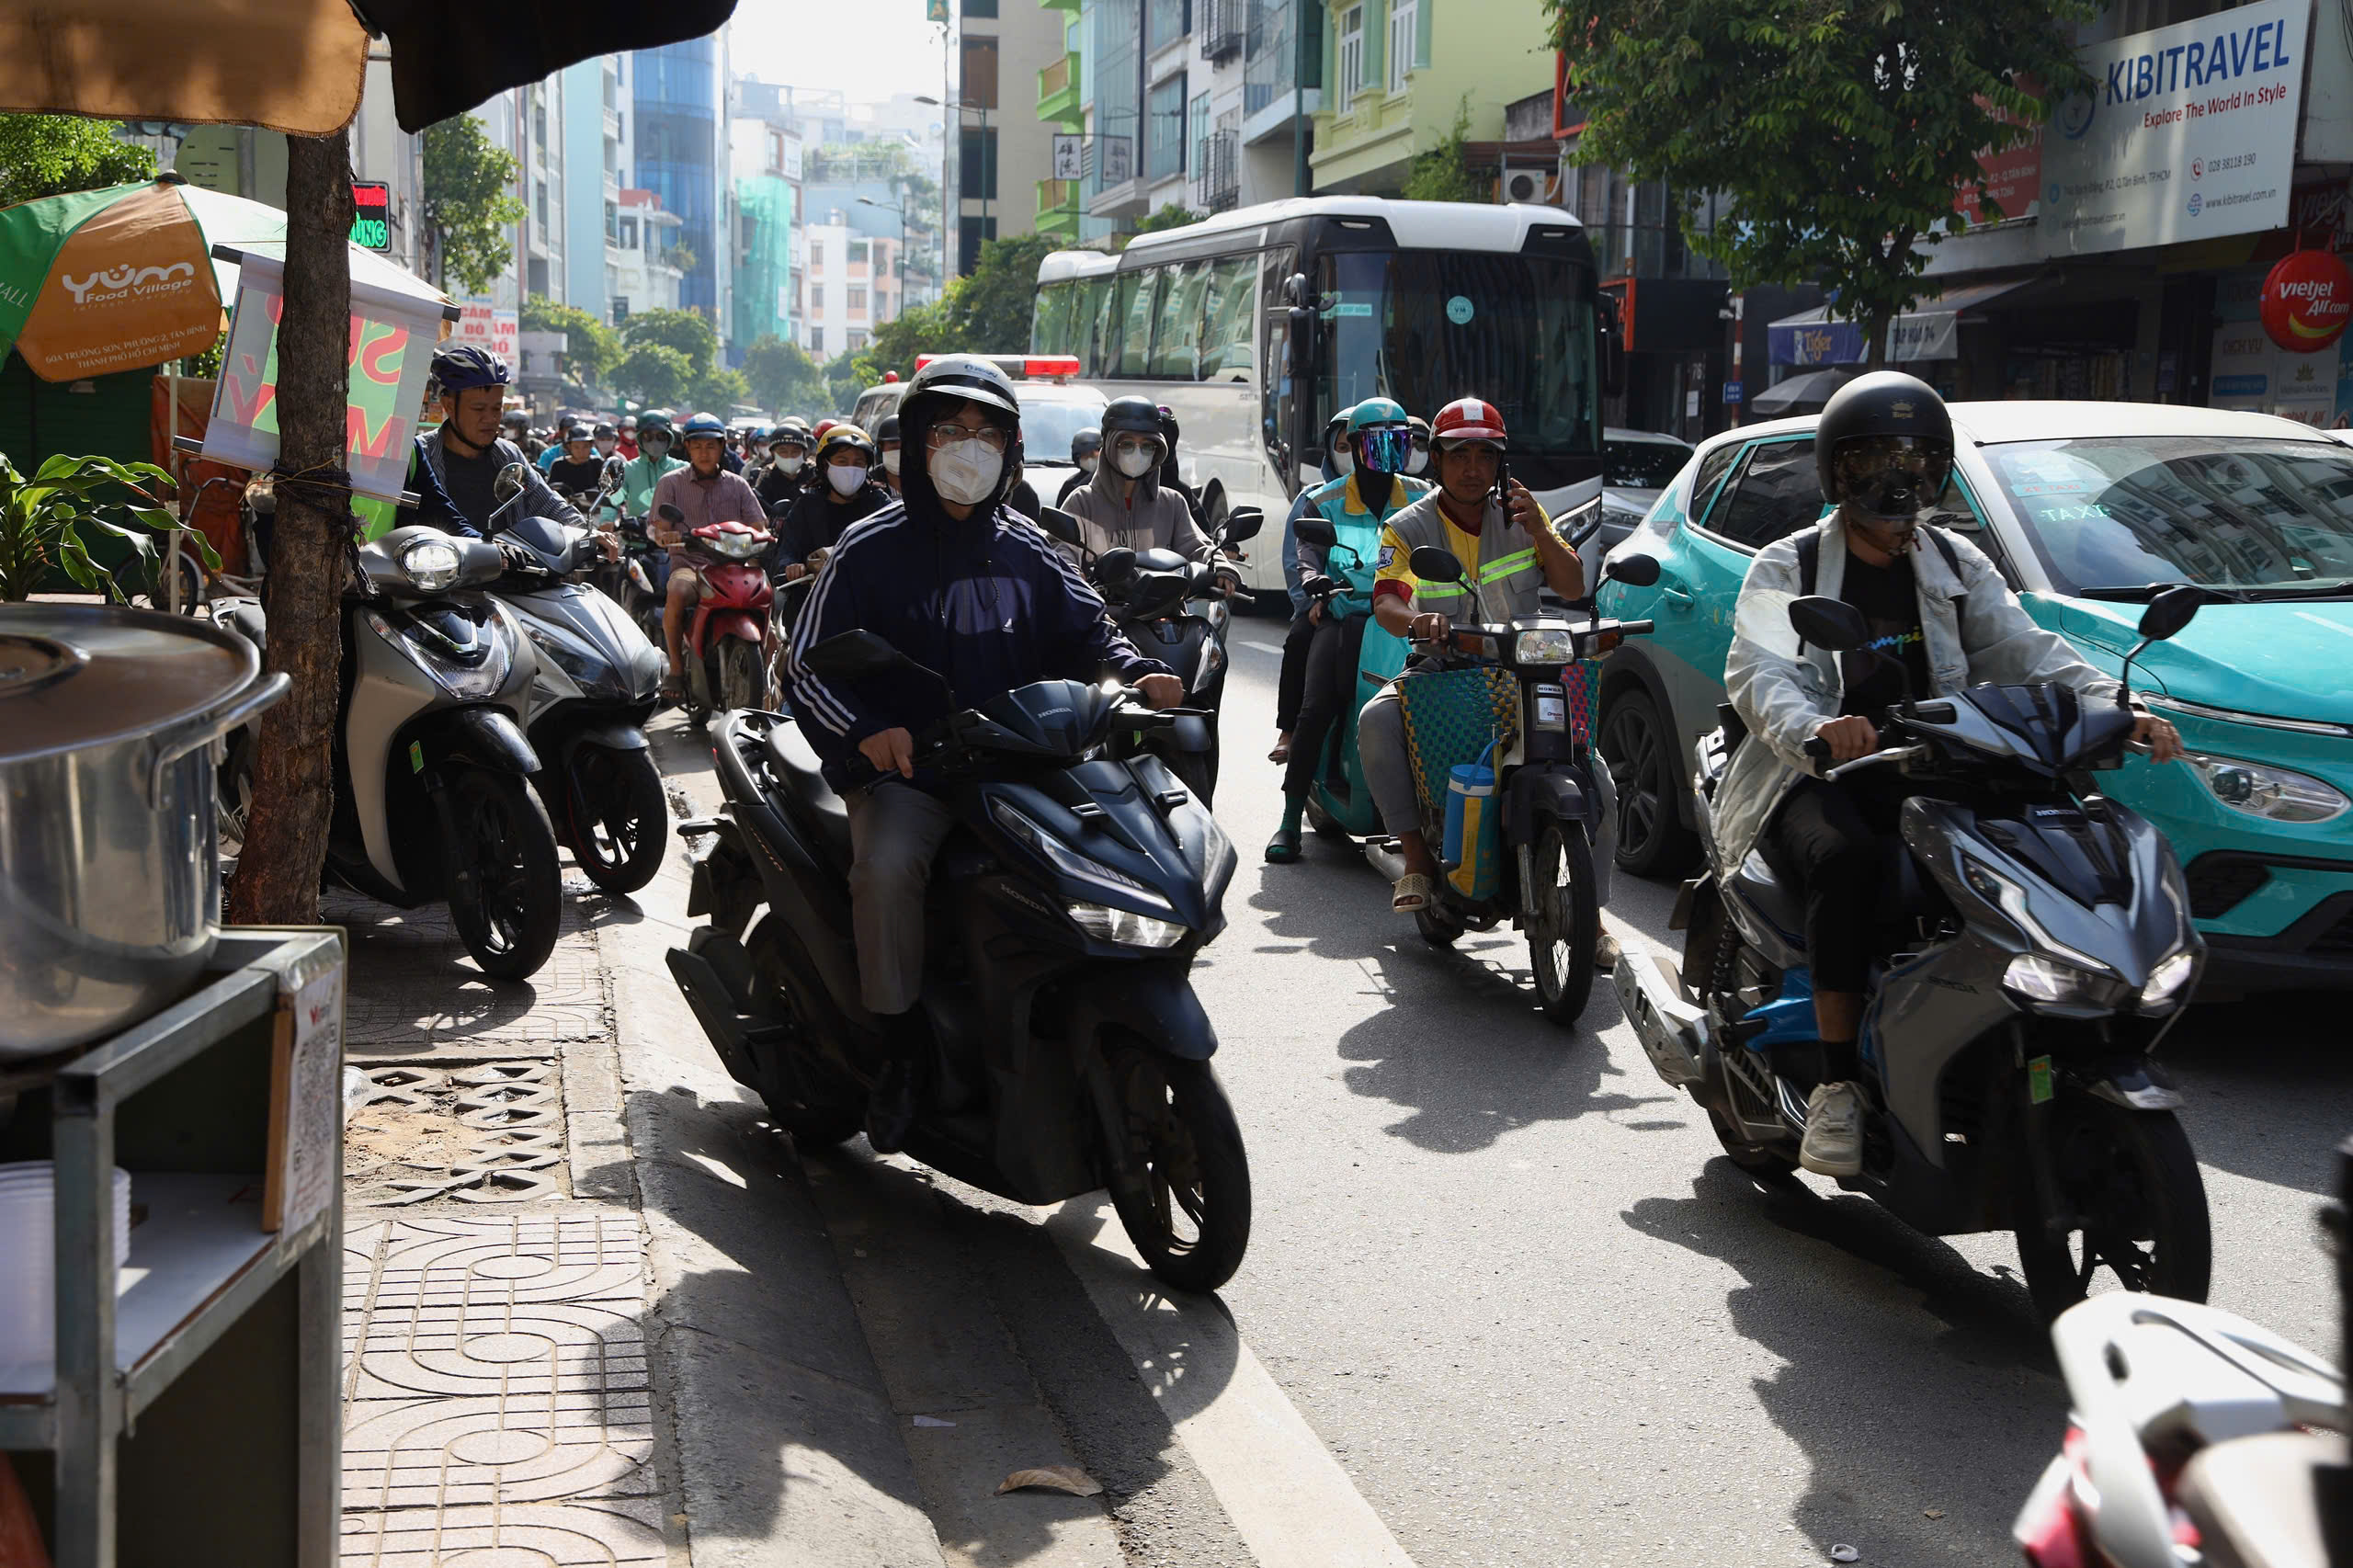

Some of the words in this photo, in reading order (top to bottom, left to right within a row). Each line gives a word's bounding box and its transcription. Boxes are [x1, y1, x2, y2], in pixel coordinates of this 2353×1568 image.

[2106, 18, 2290, 107] KIBITRAVEL
[2144, 108, 2182, 129] Explore
[2186, 100, 2204, 119] The
[2208, 95, 2241, 115] World
[2244, 91, 2255, 108] In
[2257, 83, 2287, 105] Style
[2208, 160, 2221, 173] 028
[2222, 154, 2242, 170] 38118
[2243, 153, 2256, 166] 190
[2206, 188, 2276, 209] www.kibitravel.com.vn
[0, 282, 28, 308] ALL
[86, 289, 128, 303] Food
[133, 278, 192, 296] Village
[2306, 300, 2350, 316] Air.com
[2040, 505, 2111, 522] TAXI
[1037, 707, 1074, 719] HONDA
[1000, 882, 1052, 916] HONDA
